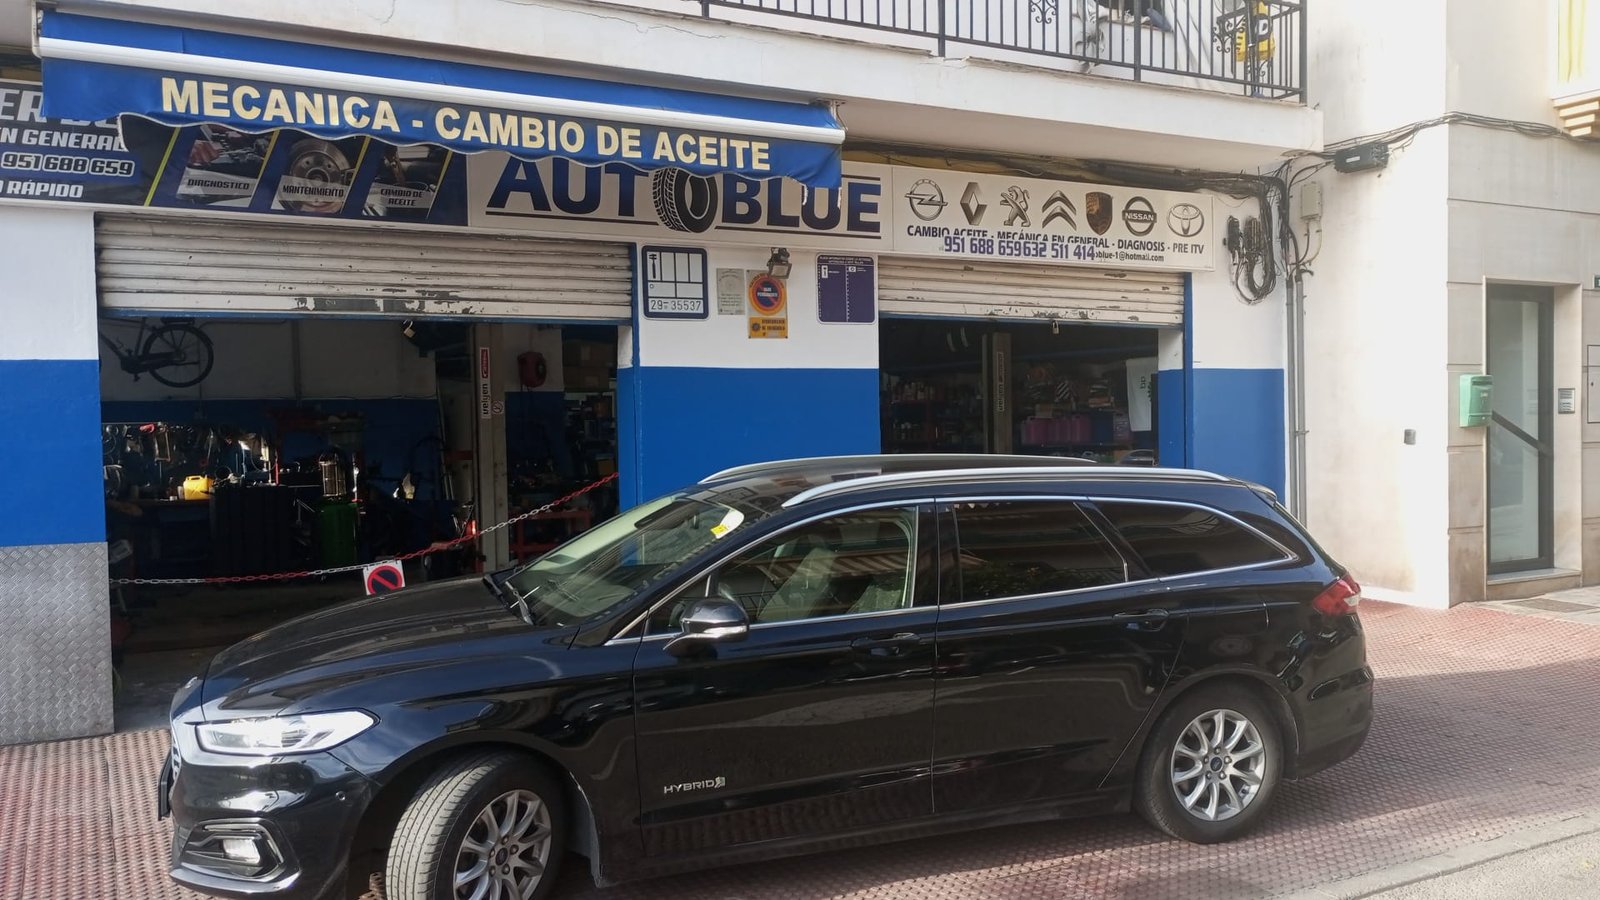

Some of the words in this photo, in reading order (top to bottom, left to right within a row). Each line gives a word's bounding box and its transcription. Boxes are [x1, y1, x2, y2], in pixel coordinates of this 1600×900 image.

[161, 77, 400, 133] MECANICA
[435, 107, 585, 153] CAMBIO
[597, 125, 642, 158] DE
[653, 131, 771, 170] ACEITE
[1, 152, 43, 171] 951
[42, 155, 90, 174] 688
[89, 158, 135, 177] 659
[6, 179, 84, 198] RÁPIDO
[187, 178, 250, 190] DIAGNOSTICO
[282, 184, 344, 198] MANTENIMIENTO
[380, 188, 411, 198] CAMBIO
[388, 197, 417, 207] ACEITE
[1125, 212, 1154, 221] NISSAN
[907, 225, 950, 238] CAMBIO
[1118, 239, 1165, 251] DIAGNOSIS
[1173, 243, 1189, 253] PRE
[1190, 244, 1205, 254] ITV
[944, 236, 965, 253] 951
[970, 238, 994, 255] 688
[1051, 243, 1069, 259] 511
[1073, 245, 1096, 260] 414
[663, 779, 715, 794] HYBRID
